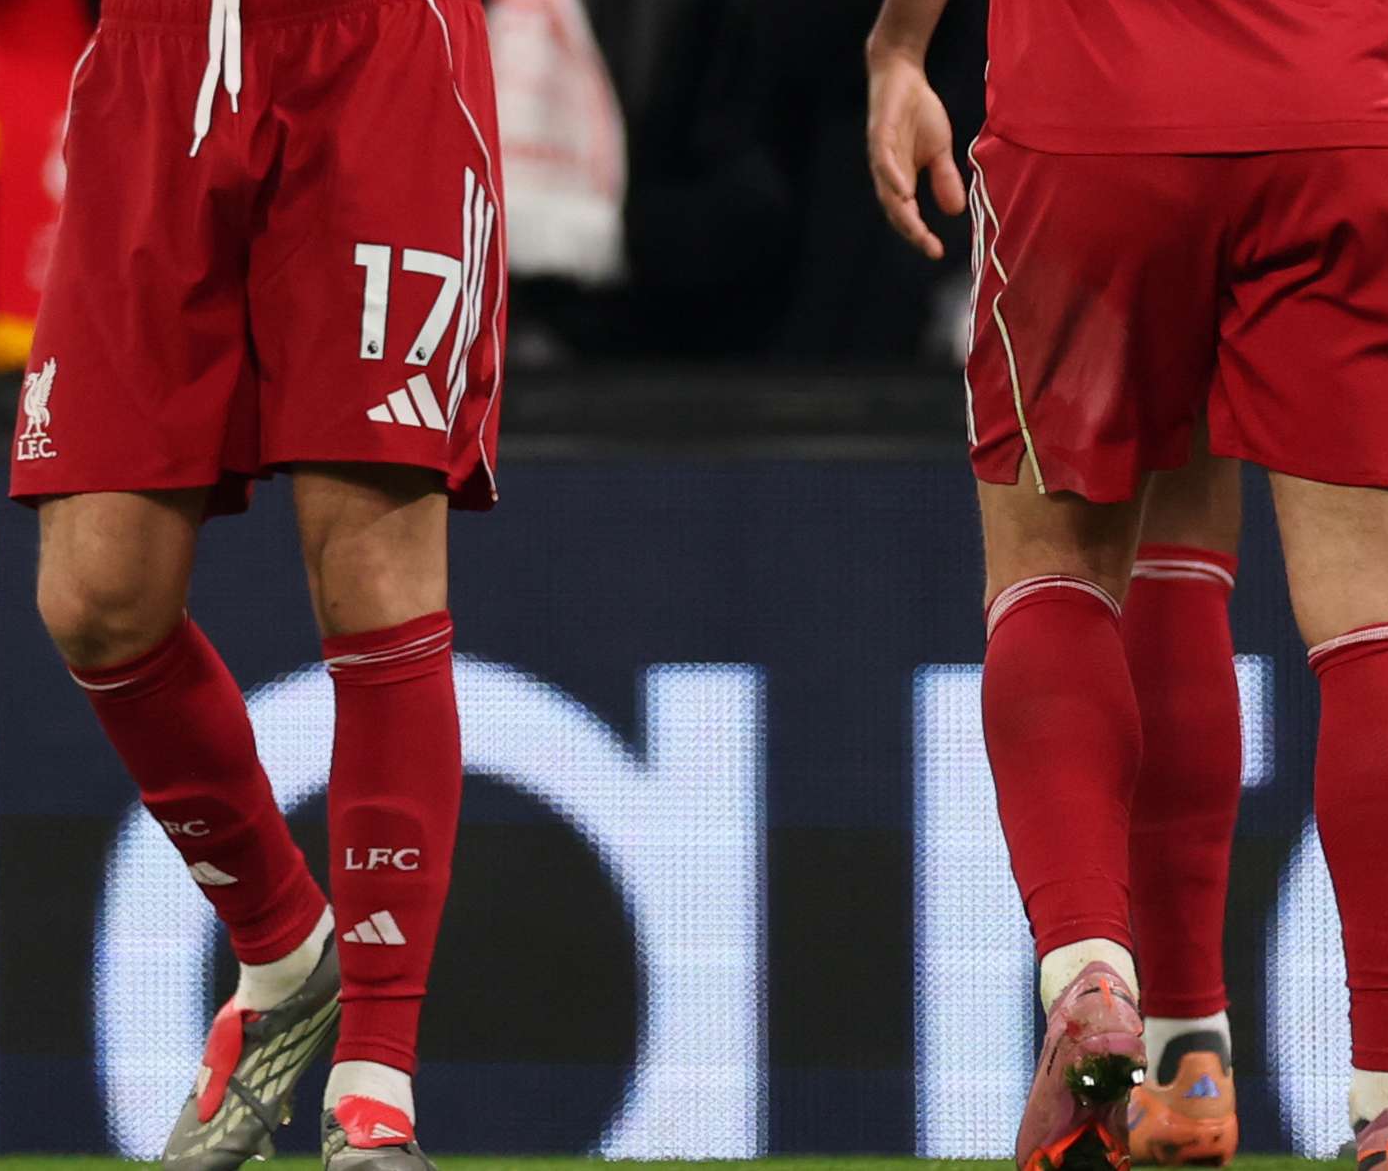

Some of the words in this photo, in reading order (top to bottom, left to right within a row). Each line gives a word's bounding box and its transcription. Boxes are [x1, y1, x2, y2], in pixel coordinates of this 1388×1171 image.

[354, 243, 463, 367] 17
[161, 819, 210, 837] FC
[344, 847, 422, 871] LFC
